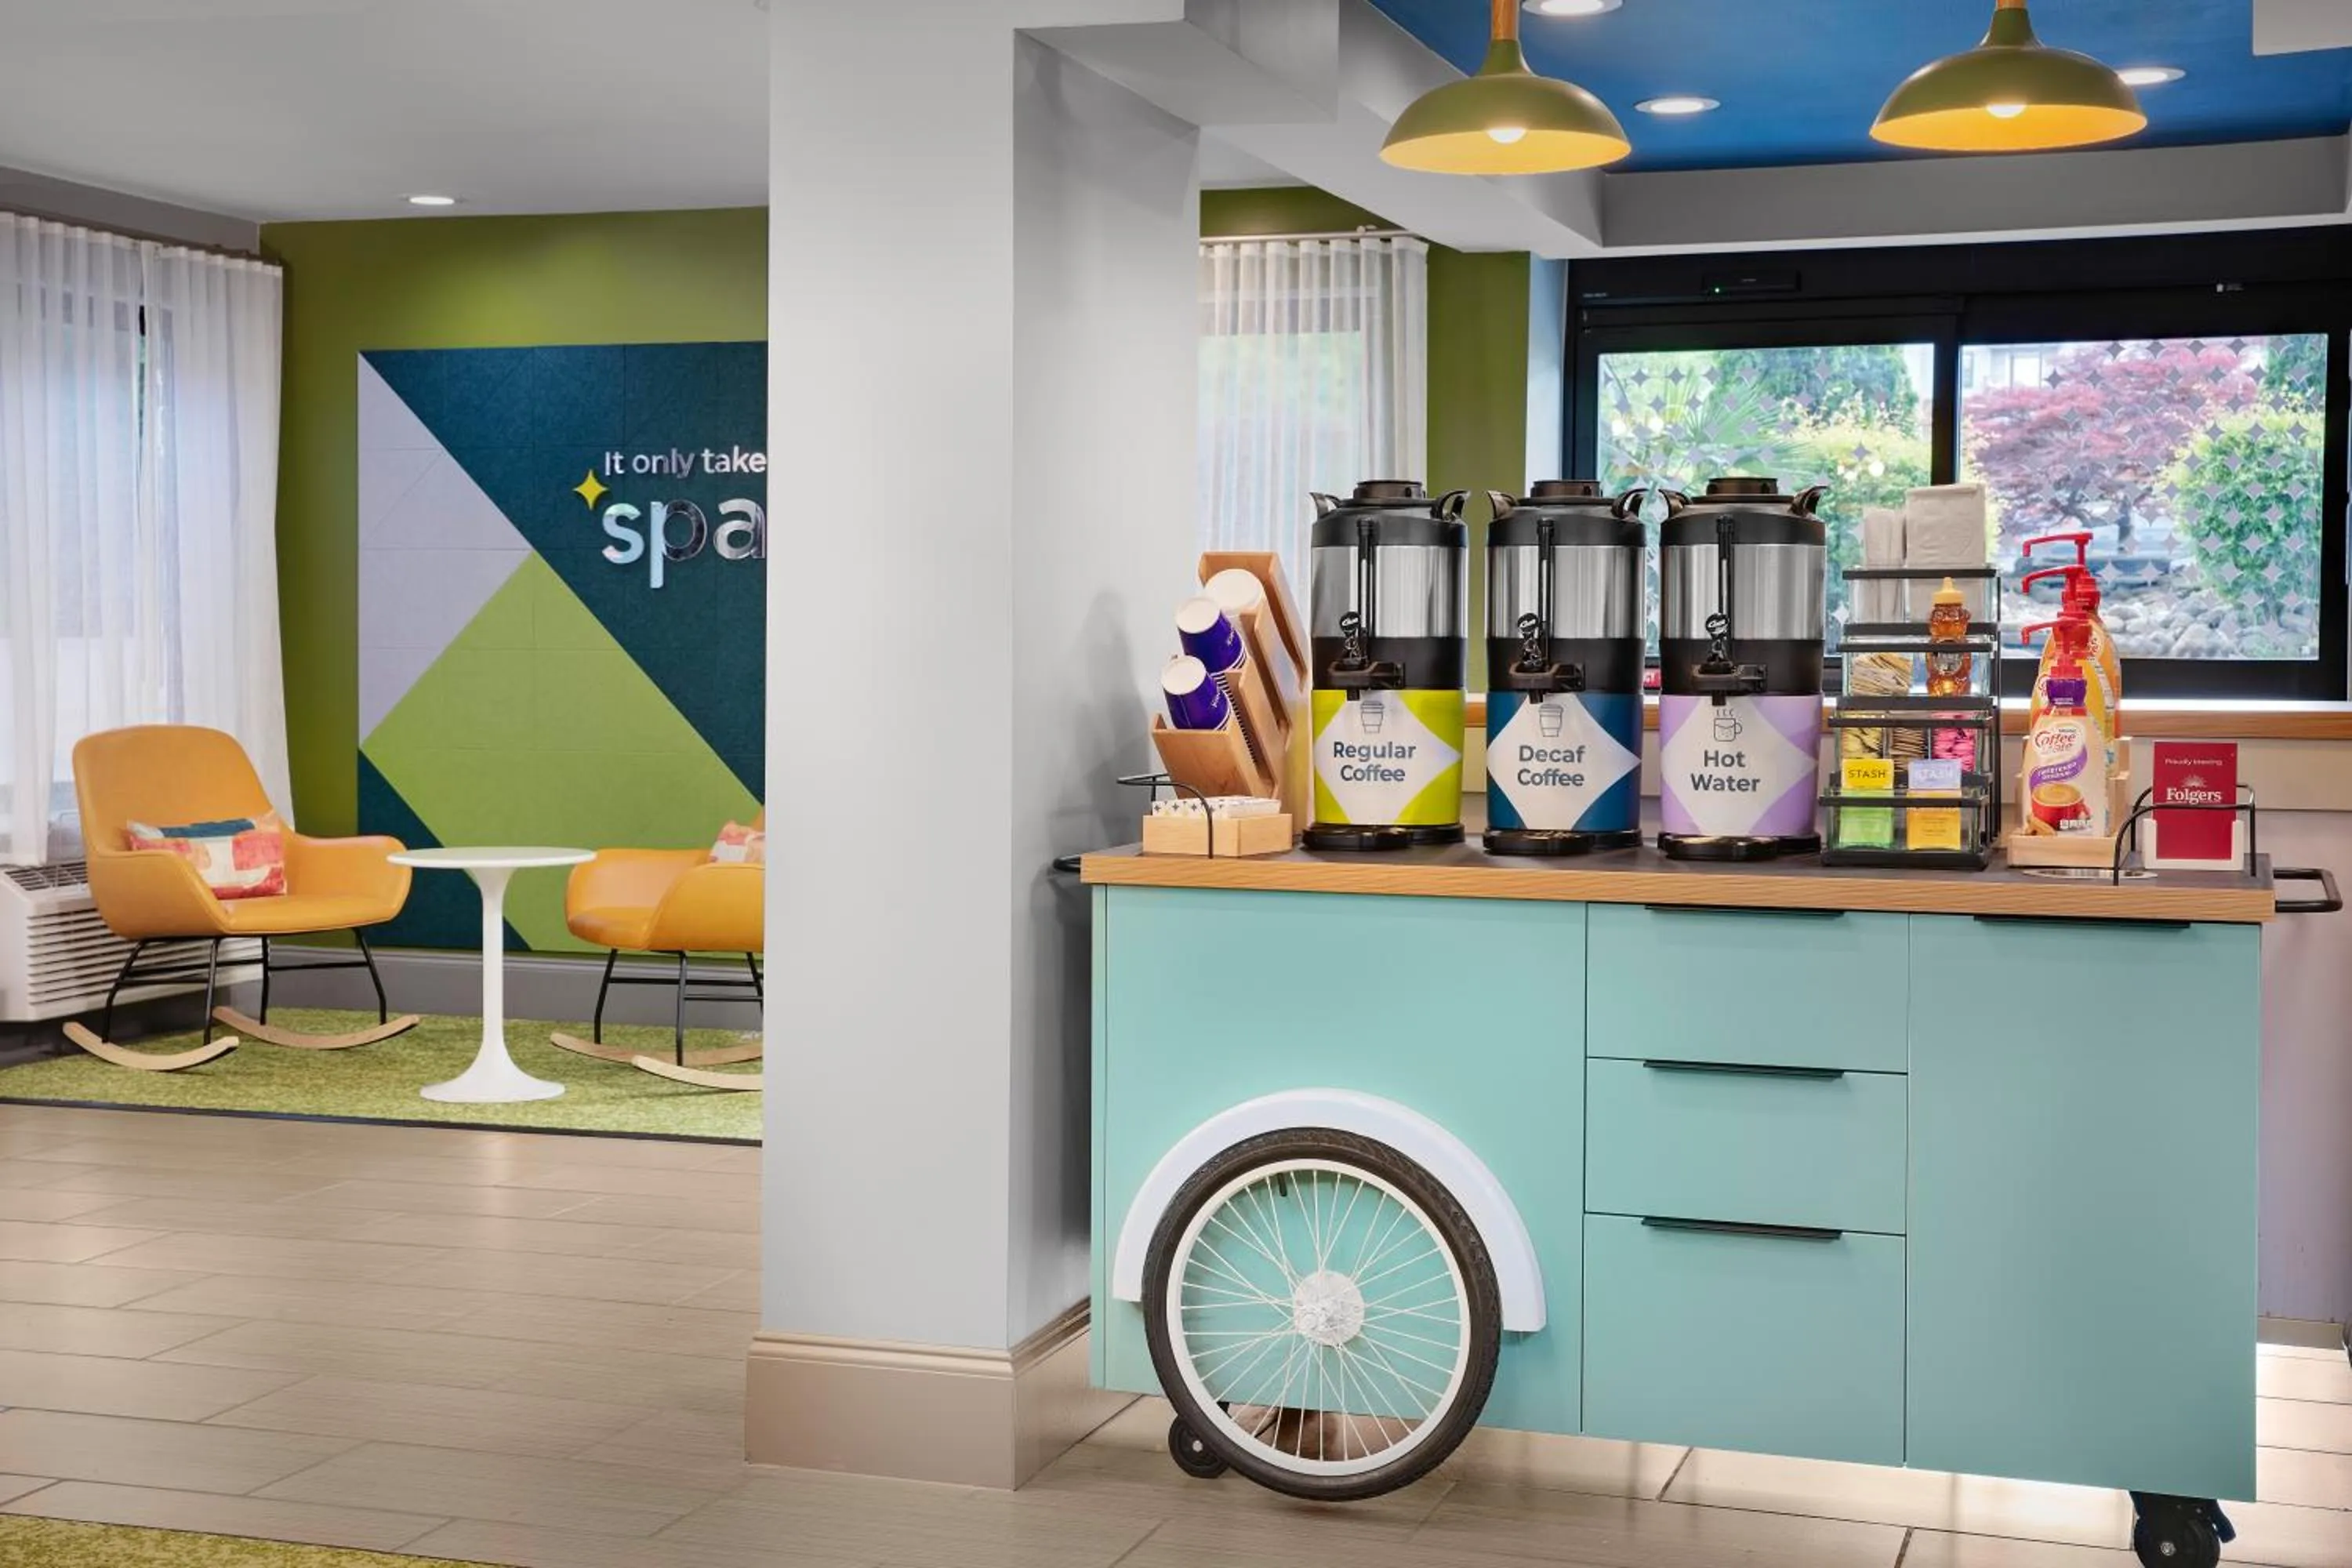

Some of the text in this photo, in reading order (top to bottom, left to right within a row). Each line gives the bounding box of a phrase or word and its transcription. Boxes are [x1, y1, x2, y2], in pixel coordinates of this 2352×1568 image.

[604, 452, 625, 476] It
[632, 448, 695, 478] only
[1334, 741, 1417, 763] Regular
[1519, 745, 1585, 763] Decaf
[1704, 750, 1746, 768] Hot
[1341, 764, 1406, 782] Coffee
[1517, 768, 1584, 786] Coffee
[1848, 768, 1886, 779] STASH
[1690, 773, 1761, 792] Water
[2166, 787, 2222, 805] Folgers
